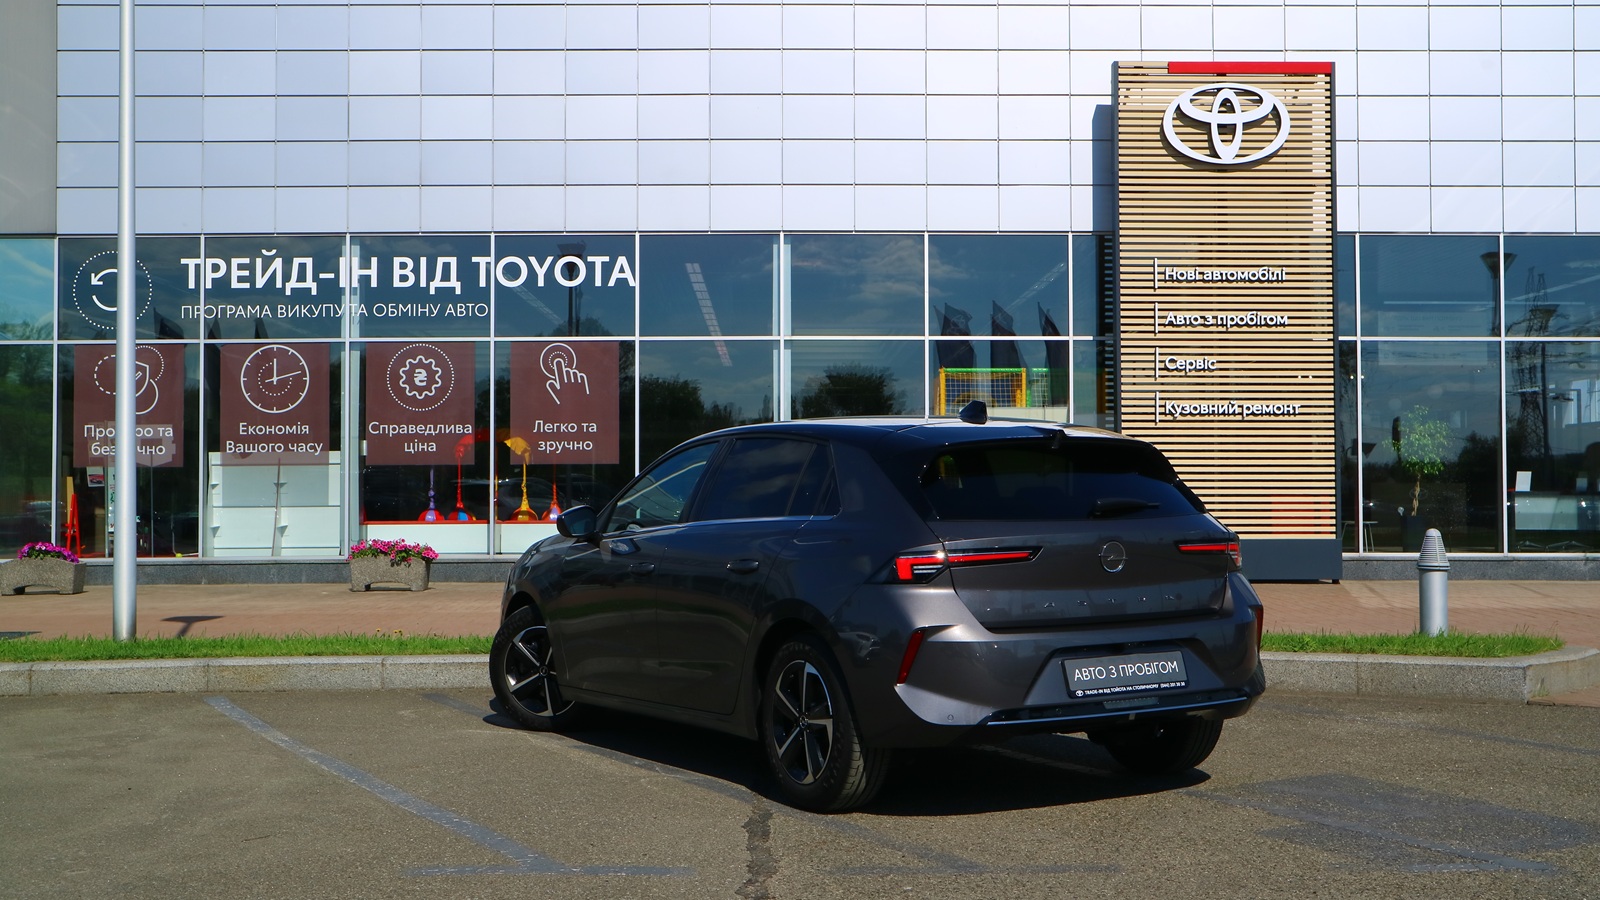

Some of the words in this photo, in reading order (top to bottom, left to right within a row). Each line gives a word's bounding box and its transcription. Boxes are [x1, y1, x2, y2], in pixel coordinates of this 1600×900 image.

[180, 249, 378, 296] ТРЕЙД-ІН
[392, 256, 461, 295] ВІД
[471, 255, 636, 288] TOYOTA
[1164, 267, 1199, 281] Нові
[1203, 266, 1286, 281] автомобілі
[181, 304, 272, 319] ПРОГРАМА
[277, 303, 345, 318] ВИКУПУ
[349, 303, 368, 317] ТА
[373, 303, 441, 317] ОБМІНУ
[445, 303, 489, 317] АВТО
[1164, 312, 1200, 325] Авто
[1204, 314, 1213, 325] з
[1217, 311, 1288, 328] пробігом
[1165, 356, 1217, 373] Сервіс
[1165, 400, 1239, 417] Кузовний
[1242, 403, 1301, 418] ремонт
[84, 424, 154, 441] Проро
[157, 427, 174, 437] та
[239, 421, 310, 435] Економія
[368, 421, 472, 438] Справедлива
[533, 420, 578, 433] Легко
[581, 422, 597, 433] та
[91, 442, 166, 455] безчно
[226, 440, 284, 453] Вашого
[290, 442, 323, 455] часу
[404, 439, 437, 454] ціна
[538, 438, 593, 454] зручно
[1074, 666, 1106, 681] АВТО
[1119, 660, 1179, 677] ПРОБІГОМ
